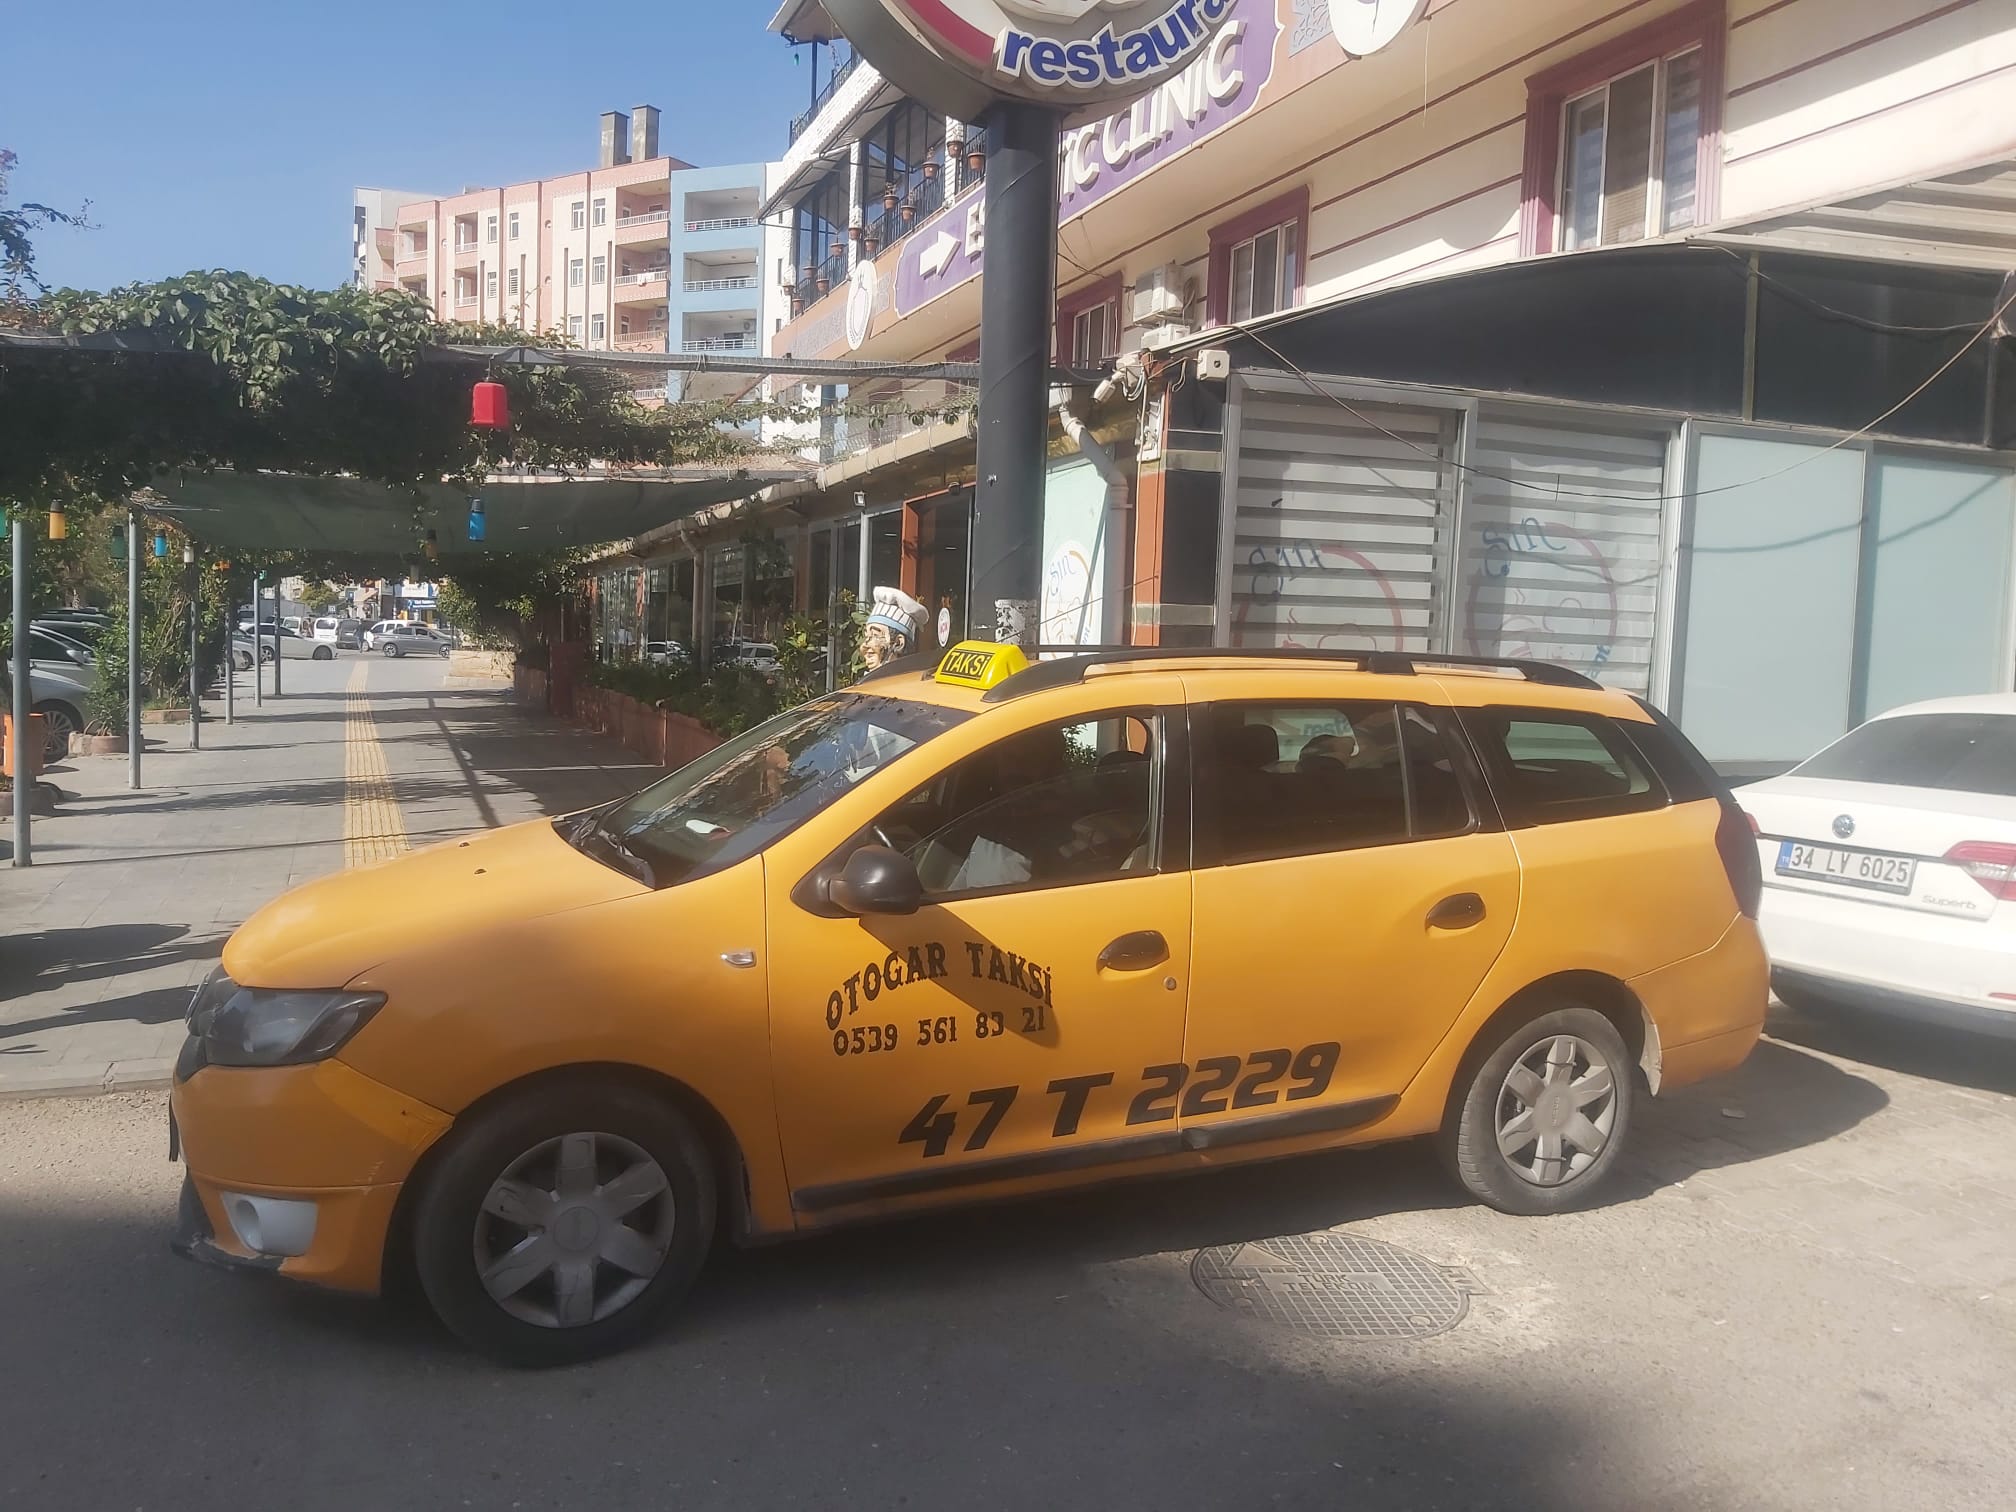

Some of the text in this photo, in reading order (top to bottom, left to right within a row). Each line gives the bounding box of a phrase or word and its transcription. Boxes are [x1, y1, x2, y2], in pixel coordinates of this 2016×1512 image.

[1102, 20, 1246, 166] CLINIC
[1792, 846, 1815, 869] 34
[1860, 856, 1909, 882] 6025
[1921, 895, 1977, 910] Superb
[826, 942, 948, 1030] OTOGAR
[833, 1006, 1045, 1056] 0539 561 83 21
[898, 1041, 1342, 1158] 47 T 2229
[1283, 1282, 1377, 1291] TELEKOM
